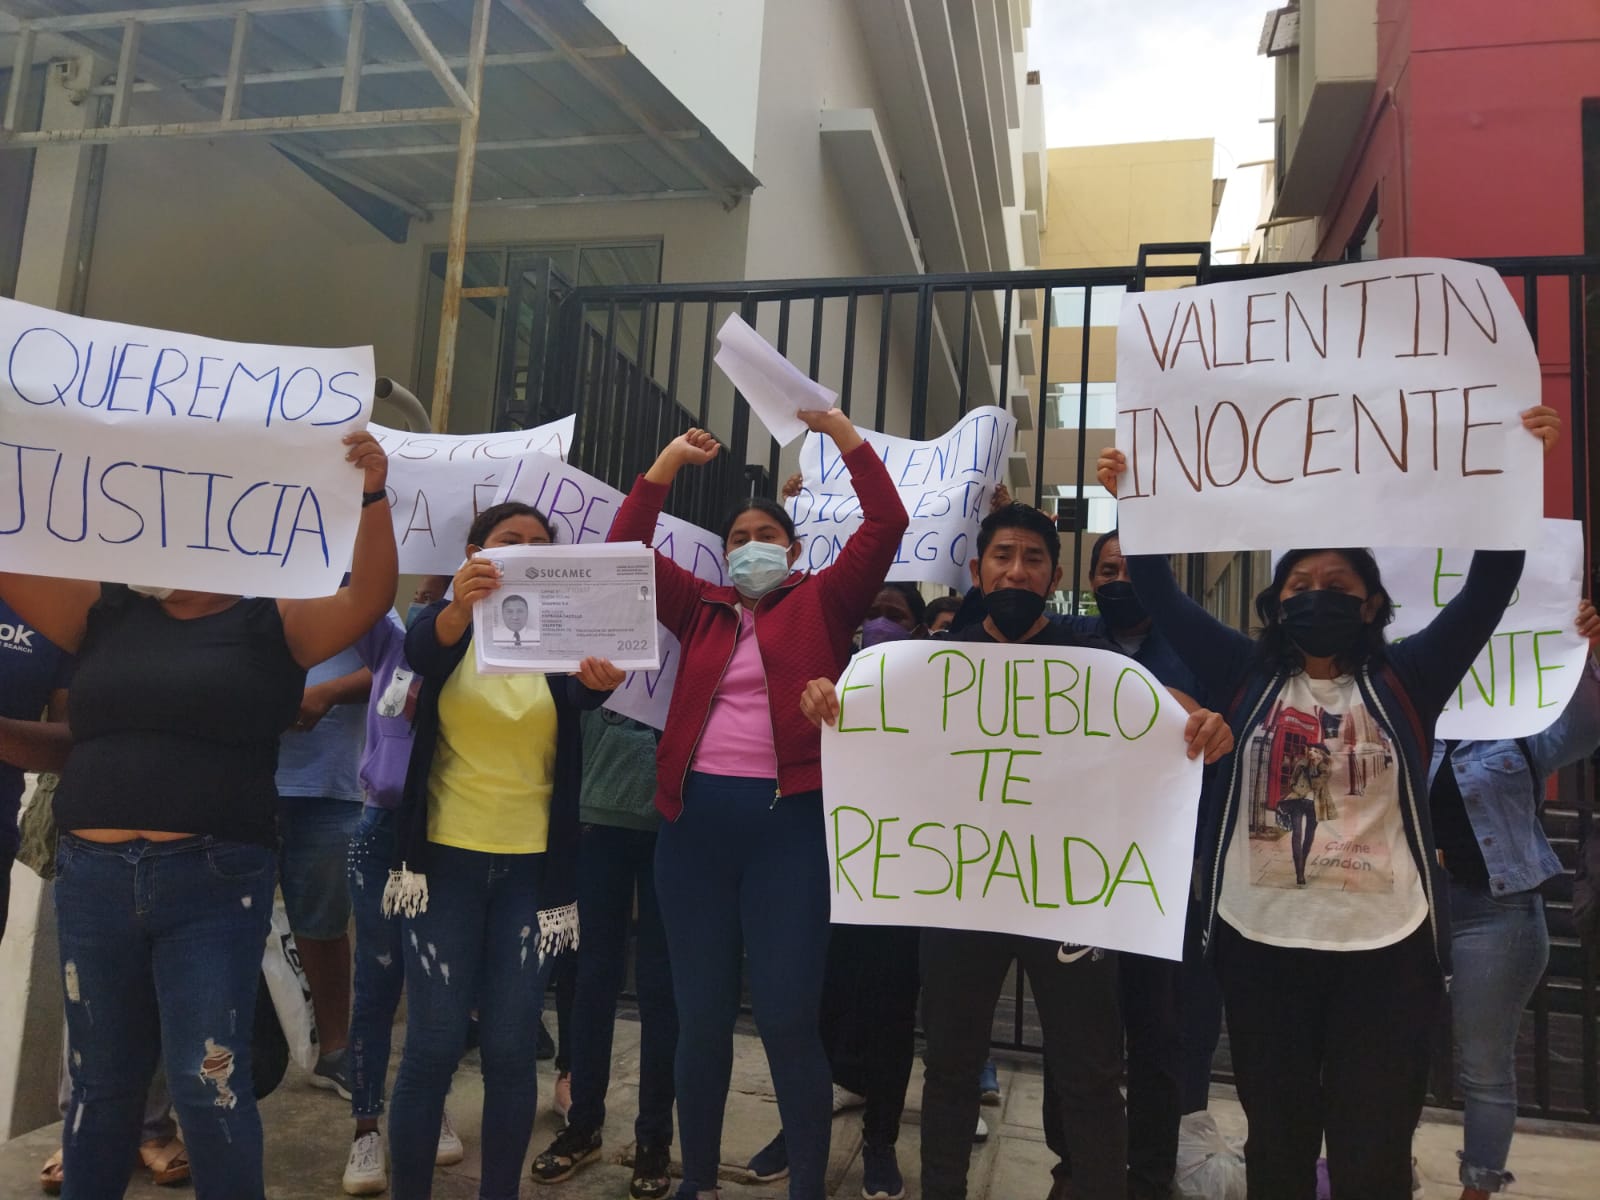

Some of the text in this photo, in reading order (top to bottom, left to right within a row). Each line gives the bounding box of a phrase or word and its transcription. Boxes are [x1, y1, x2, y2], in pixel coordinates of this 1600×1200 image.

[1138, 273, 1497, 371] VALENTIN
[9, 327, 362, 427] QUEREMOS
[1119, 385, 1504, 499] INOCENTE
[0, 442, 329, 567] JUSTICIA
[540, 568, 592, 578] SUCAMEC
[617, 639, 648, 651] 2022
[839, 650, 1160, 741] EL PUEBLO
[951, 748, 1042, 805] TE
[830, 806, 1165, 916] RESPALDA
[1311, 855, 1371, 871] London
